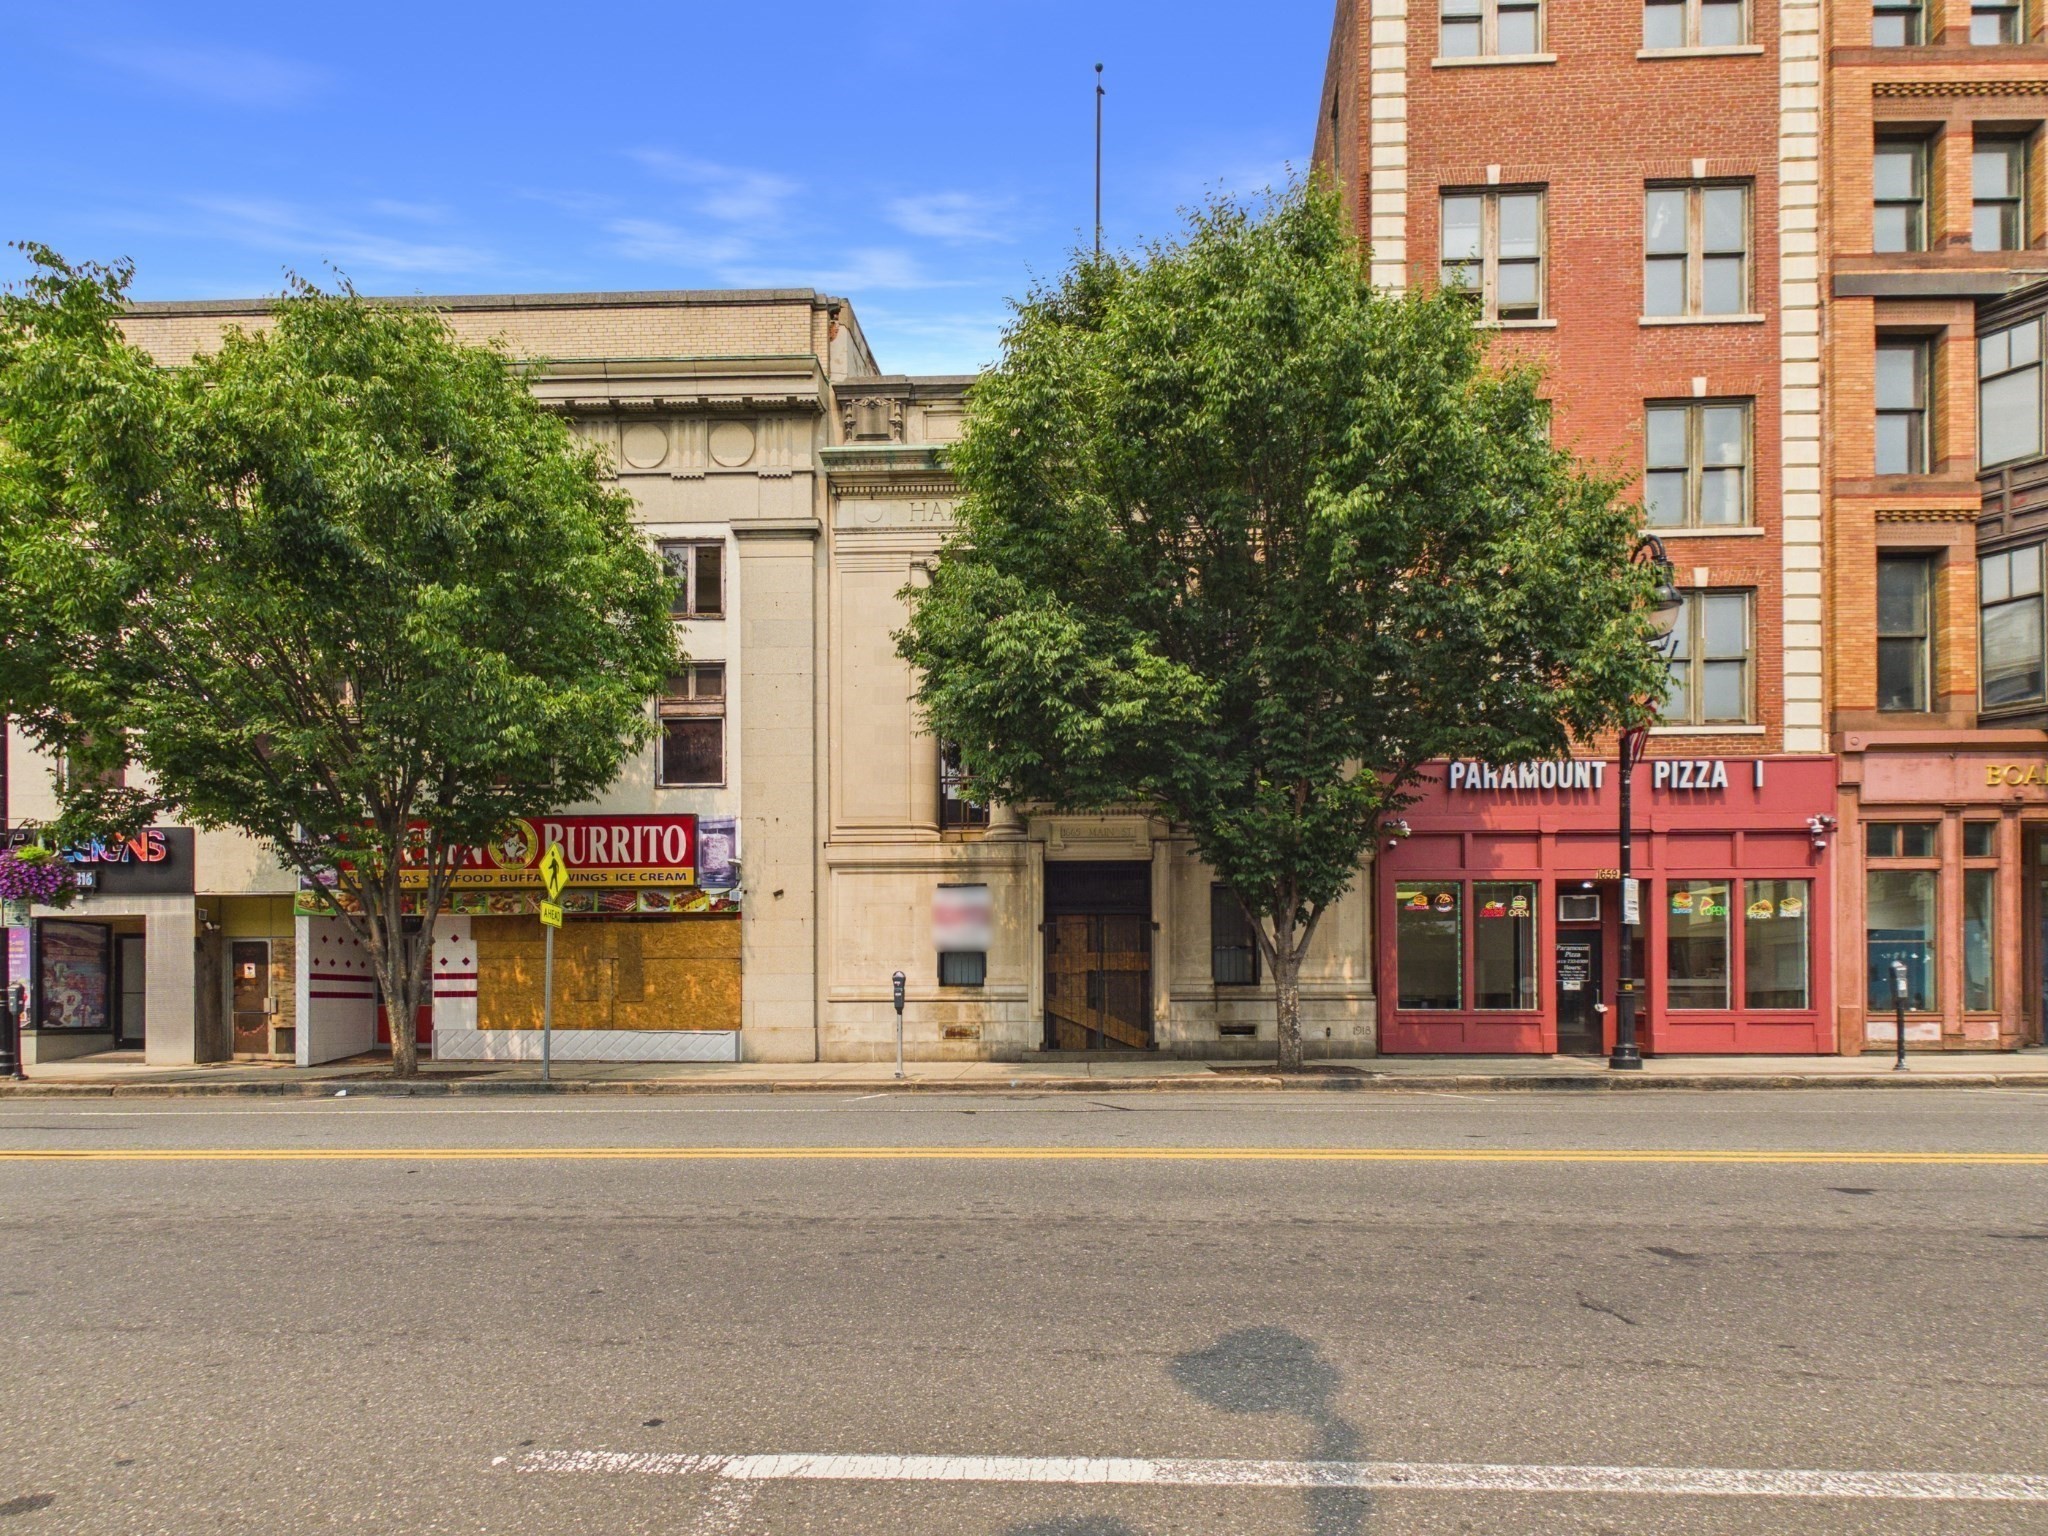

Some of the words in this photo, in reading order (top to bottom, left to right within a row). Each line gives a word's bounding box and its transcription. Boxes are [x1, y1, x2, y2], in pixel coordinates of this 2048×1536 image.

[1449, 760, 1607, 789] PARAMOUNT
[1652, 760, 1728, 788] PIZZA
[1986, 764, 2048, 786] BOA
[1089, 827, 1115, 837] MAIN
[543, 823, 687, 864] BURRITO
[427, 873, 494, 883] AFOOD
[499, 873, 542, 883] BUFFA
[615, 872, 637, 882] ICE
[639, 872, 687, 882] CREAM
[1597, 868, 1618, 879] 1659
[543, 907, 560, 922] AHEAD
[1508, 908, 1530, 917] OPEN
[1352, 1025, 1372, 1036] 1918
